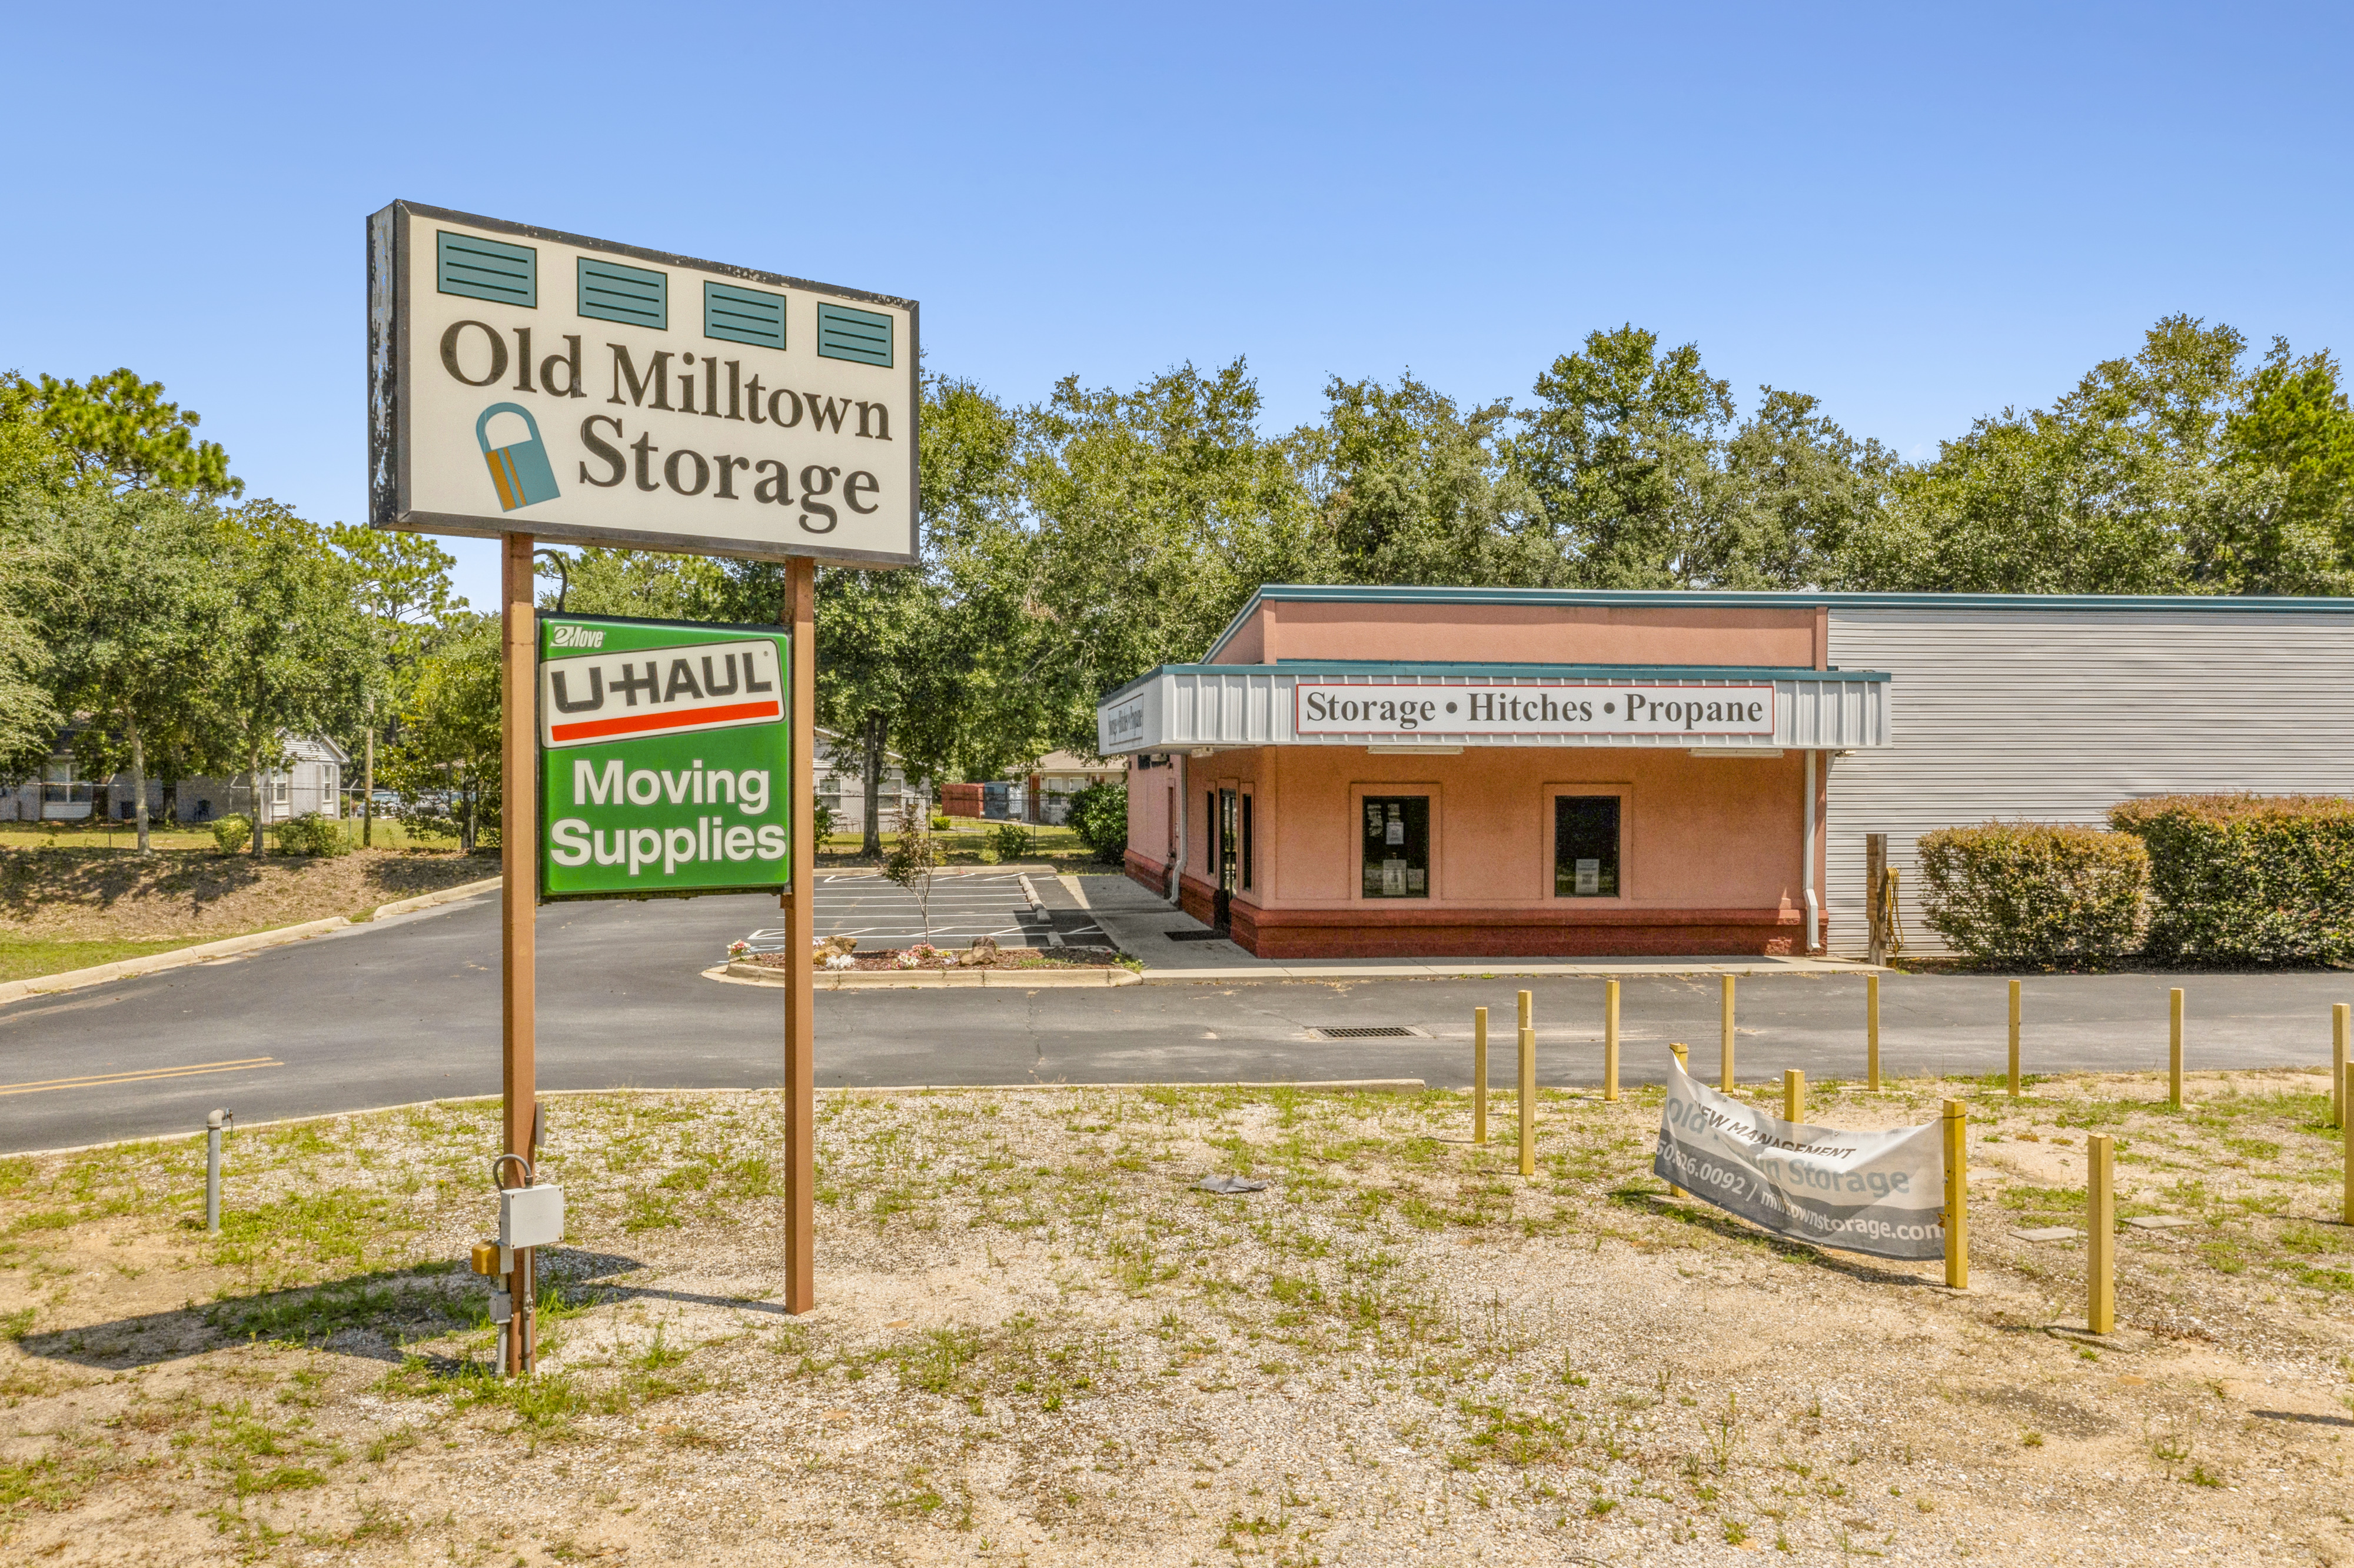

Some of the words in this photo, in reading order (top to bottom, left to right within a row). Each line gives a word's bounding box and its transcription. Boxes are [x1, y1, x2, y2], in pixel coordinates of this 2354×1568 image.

[440, 320, 587, 398] Old
[606, 344, 893, 441] Milltown
[579, 414, 880, 534] Storage
[1307, 692, 1435, 730] Storage
[1467, 693, 1592, 721] Hitches
[1624, 693, 1763, 730] Propane
[573, 759, 769, 815] Moving
[551, 817, 786, 876] Supplies
[1788, 1158, 1910, 1198] Storage
